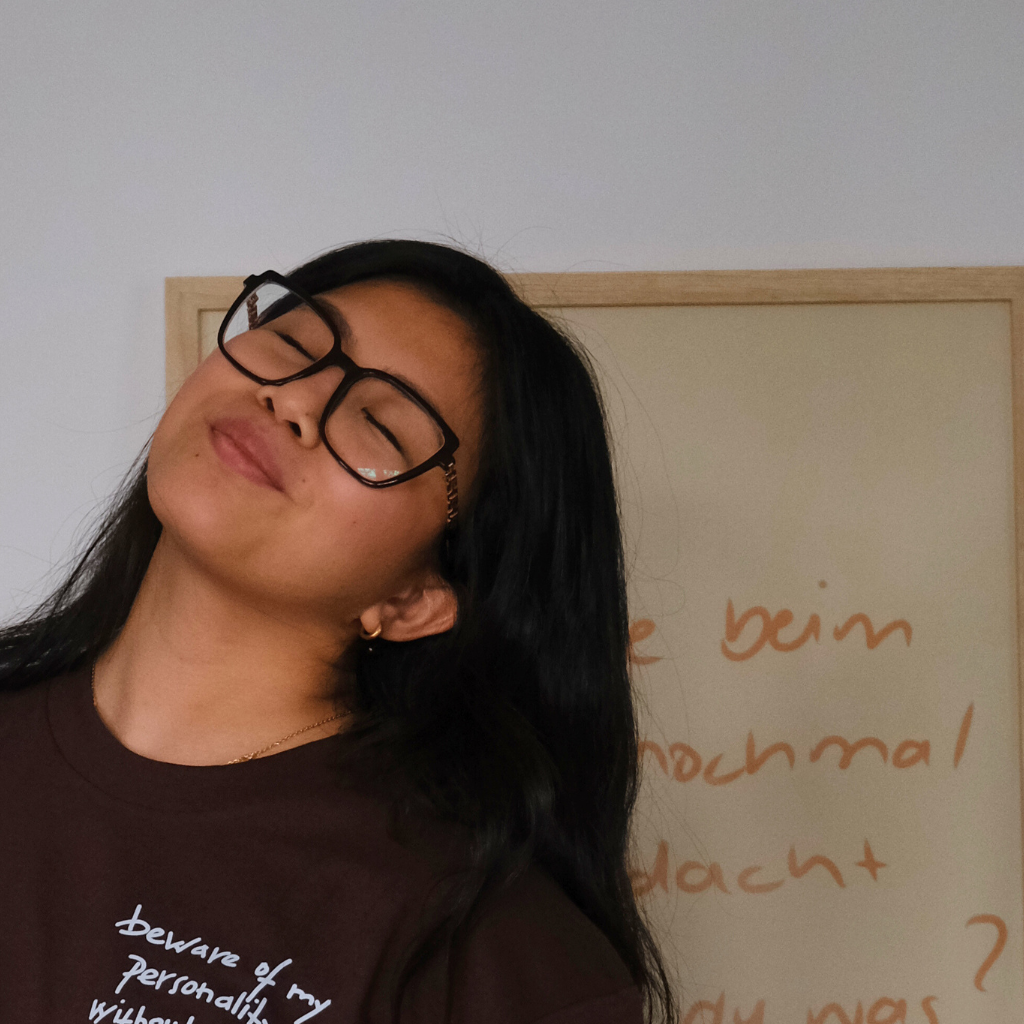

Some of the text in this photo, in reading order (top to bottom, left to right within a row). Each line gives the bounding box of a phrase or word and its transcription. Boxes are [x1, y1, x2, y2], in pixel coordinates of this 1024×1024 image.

[720, 579, 913, 662] beim
[114, 903, 241, 969] beware
[245, 958, 293, 1004] of
